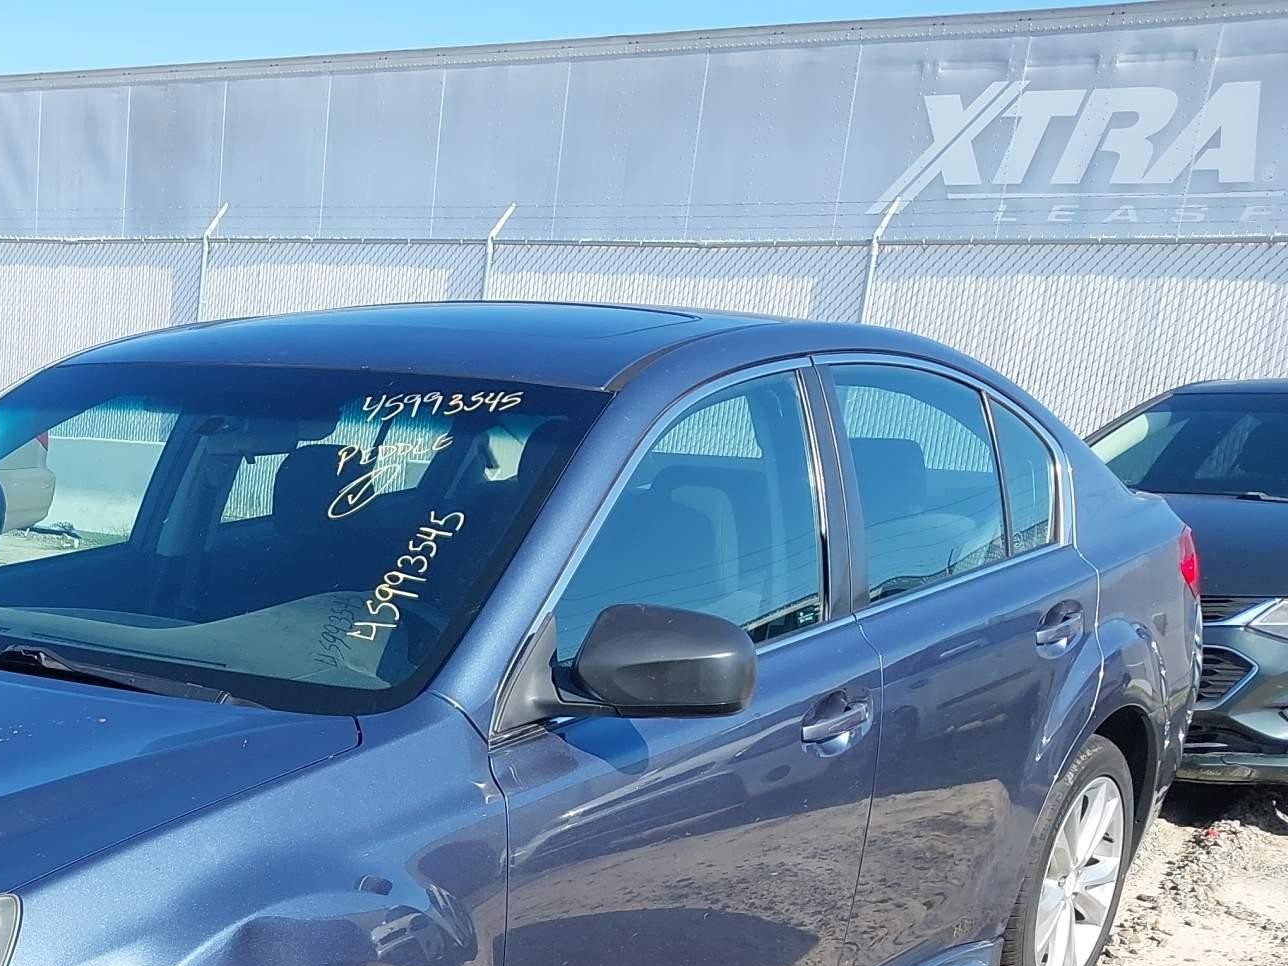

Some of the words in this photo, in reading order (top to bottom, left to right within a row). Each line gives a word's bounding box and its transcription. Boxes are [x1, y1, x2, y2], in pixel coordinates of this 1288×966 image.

[866, 80, 1263, 215] XTRA
[362, 391, 524, 422] 45993545
[346, 510, 465, 641] 45993545
